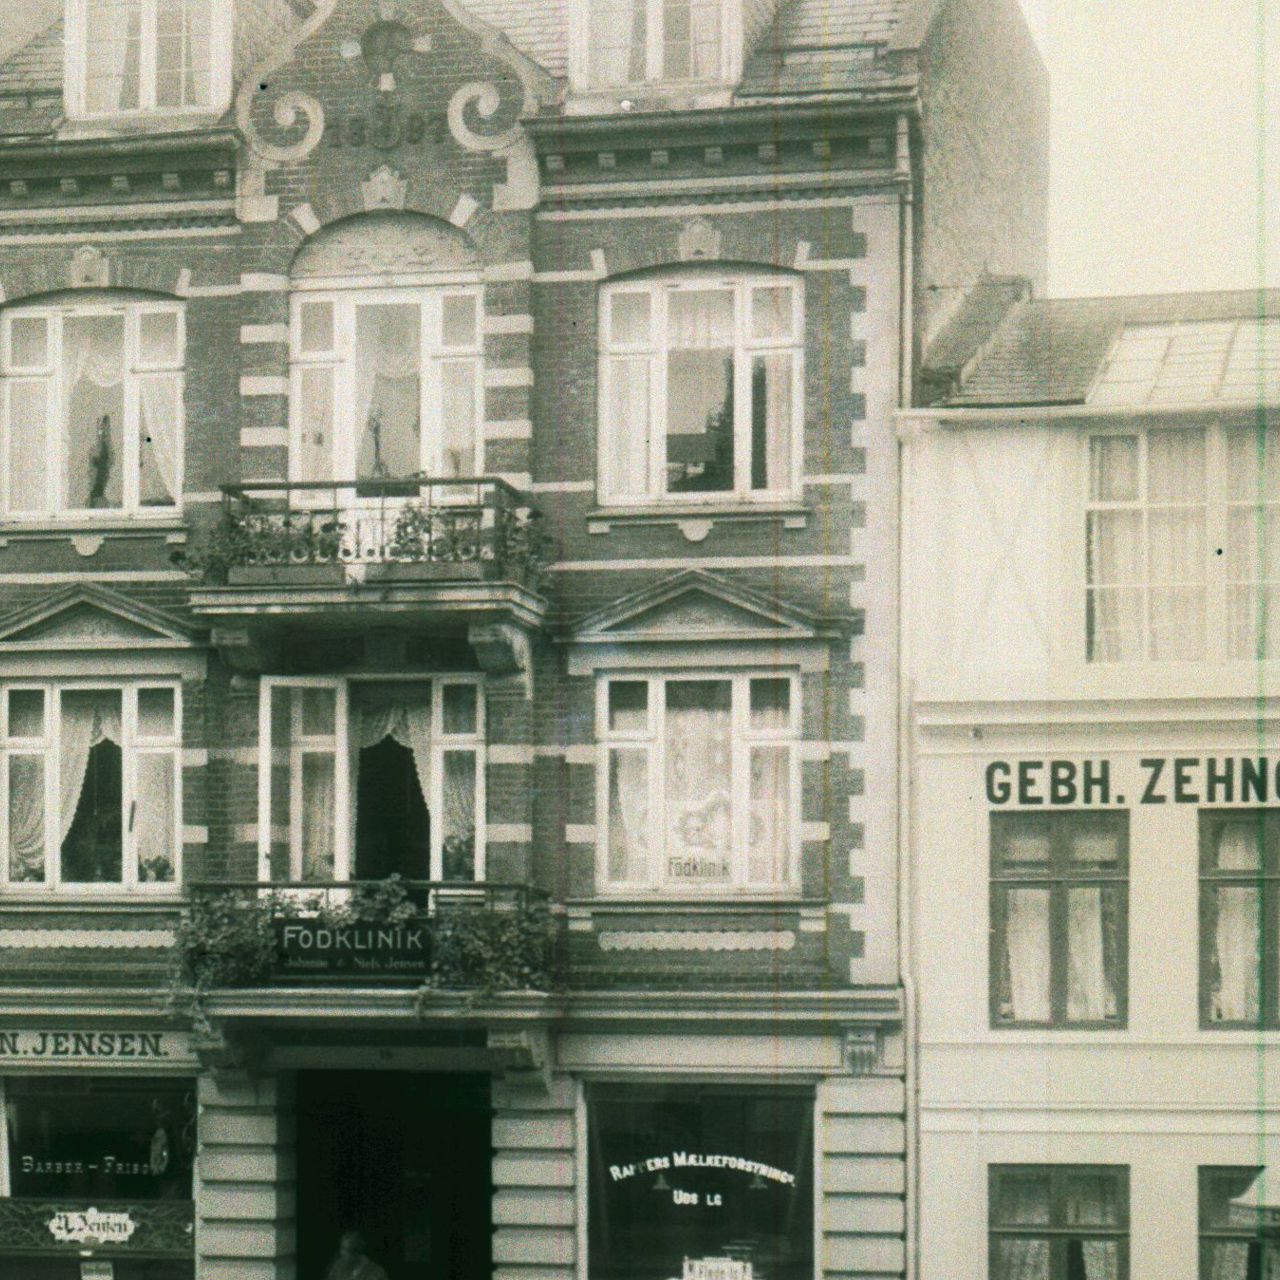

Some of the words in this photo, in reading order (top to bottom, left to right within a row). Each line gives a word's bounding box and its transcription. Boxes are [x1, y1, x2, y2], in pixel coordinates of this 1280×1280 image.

[985, 761, 1125, 804] GEBH.
[283, 925, 423, 950] FODKLINIK
[673, 1189, 723, 1206] UDSLG
